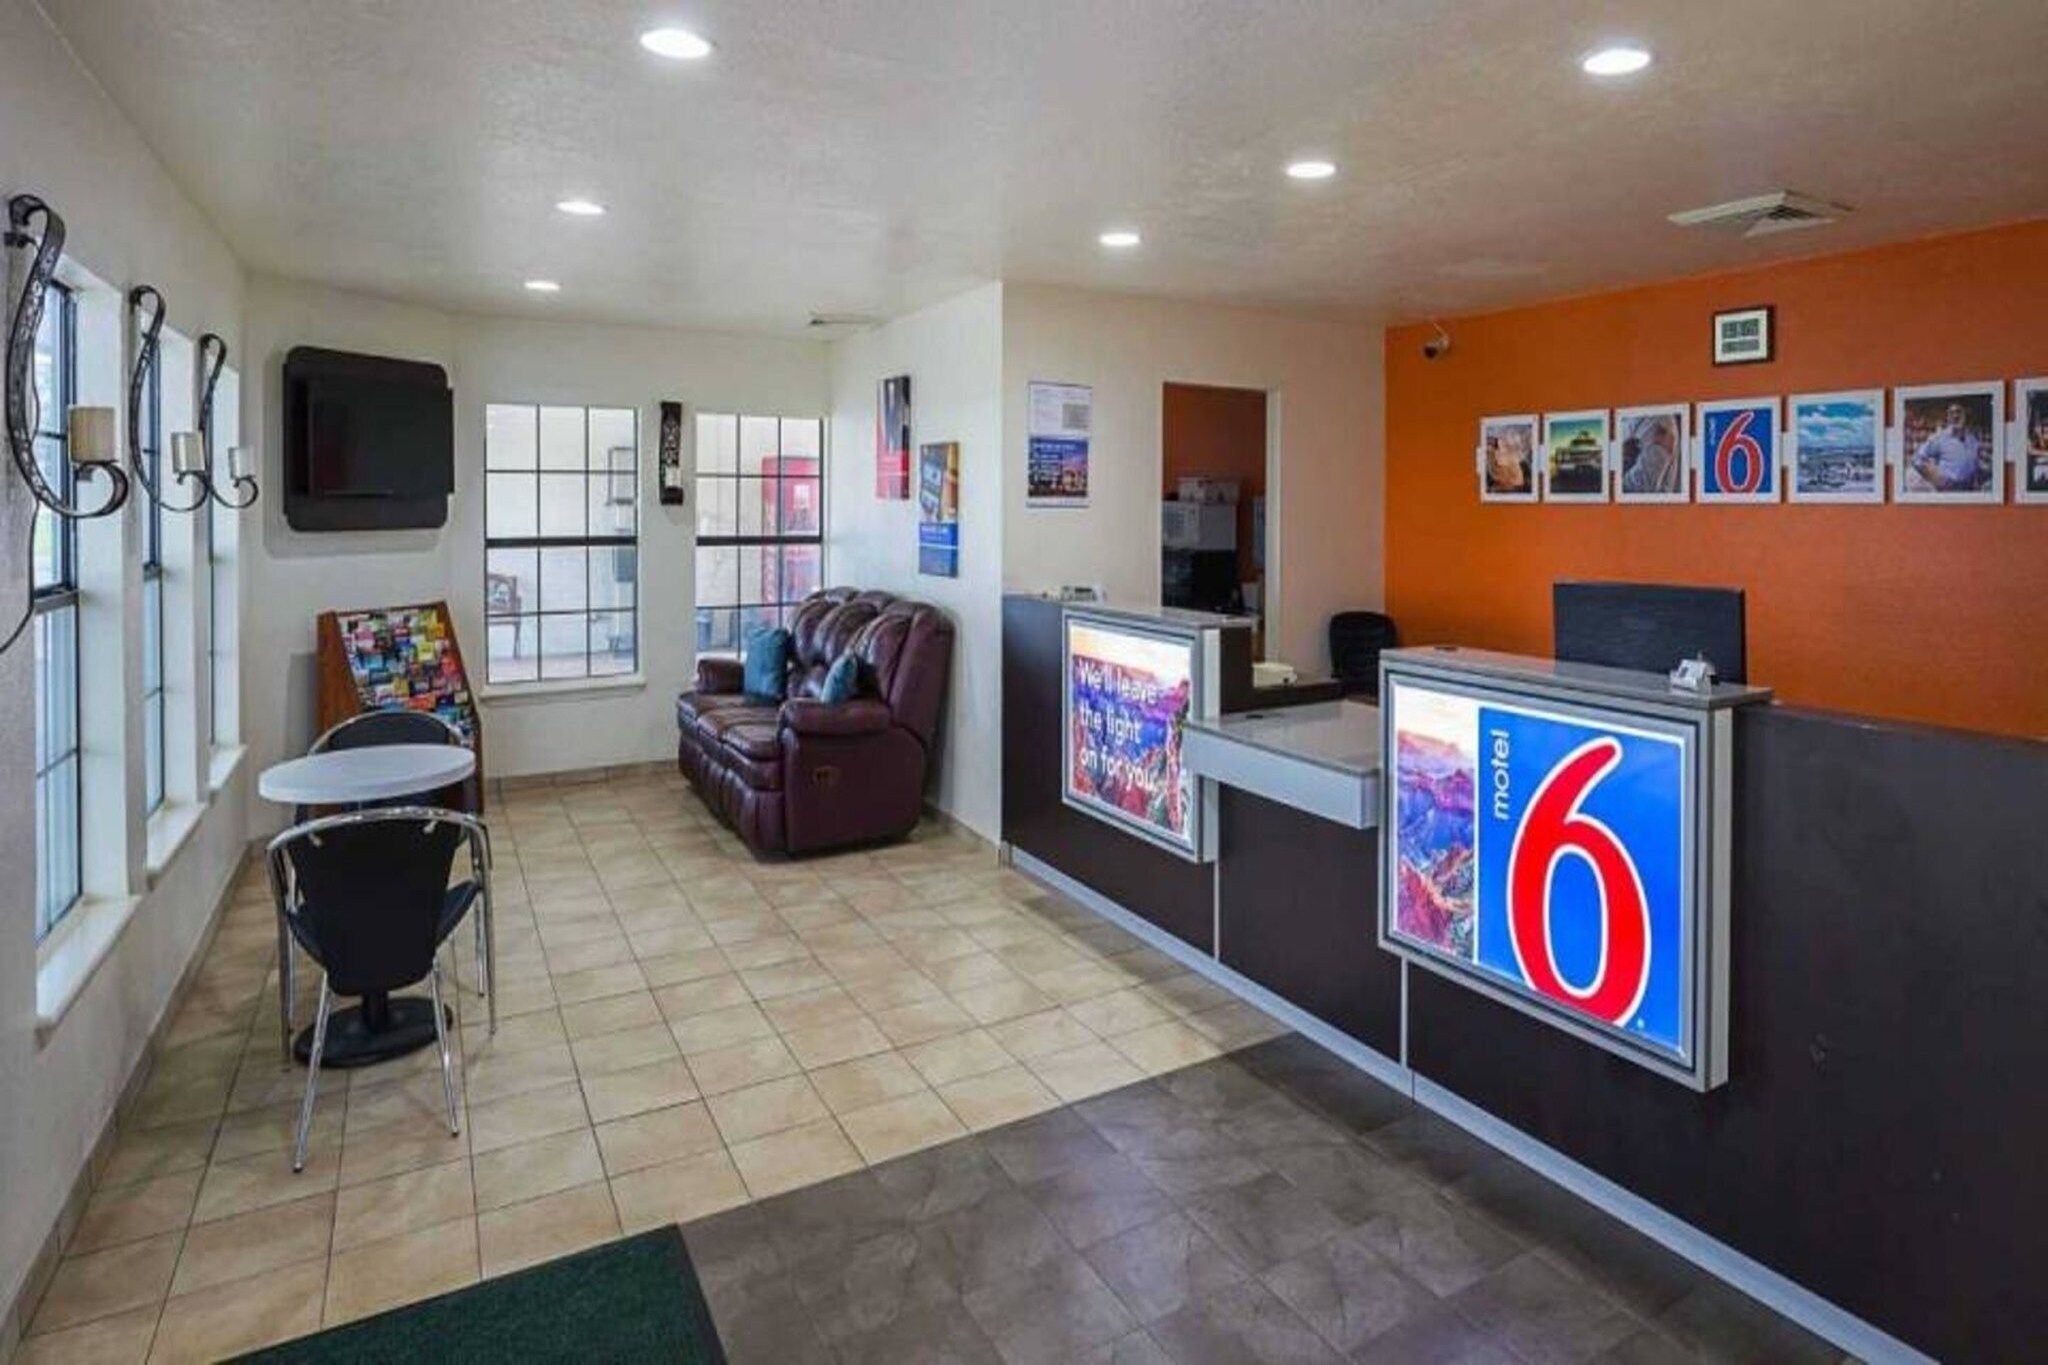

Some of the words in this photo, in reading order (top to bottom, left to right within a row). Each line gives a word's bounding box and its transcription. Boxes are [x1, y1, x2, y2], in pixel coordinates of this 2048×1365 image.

[1714, 410, 1765, 495] 6
[1116, 668, 1158, 704] leave
[1079, 701, 1102, 731] the
[1106, 707, 1141, 744] light
[1079, 745, 1098, 768] on
[1100, 744, 1123, 777] for
[1490, 729, 1511, 820] motel
[1506, 736, 1652, 1028] 6
